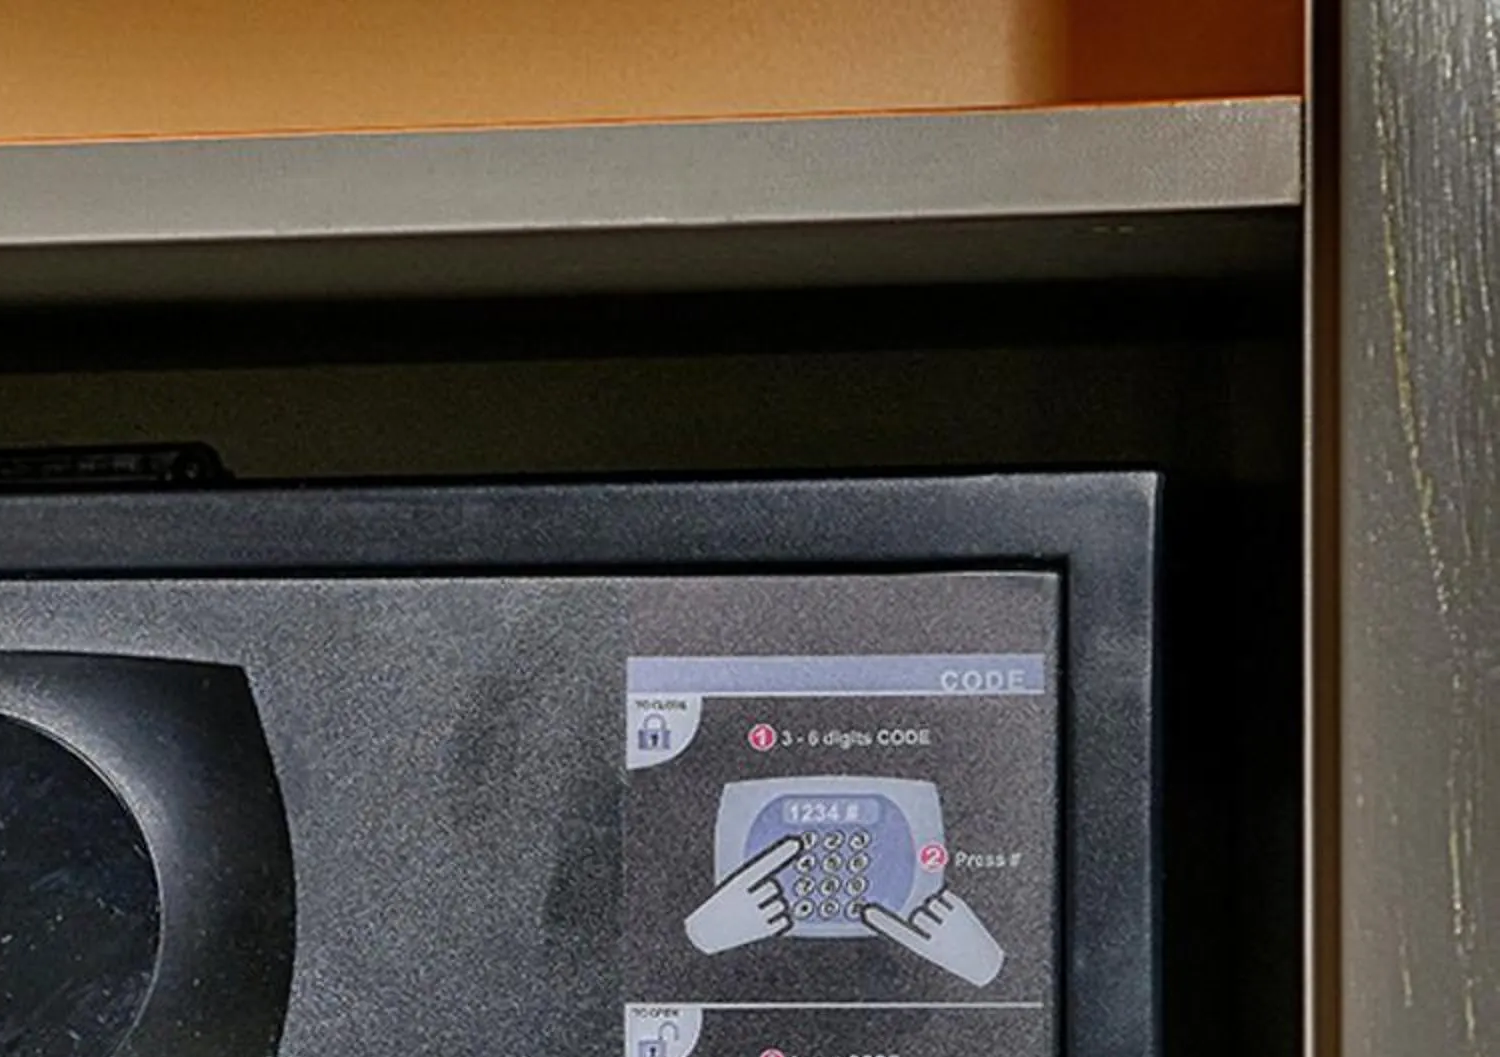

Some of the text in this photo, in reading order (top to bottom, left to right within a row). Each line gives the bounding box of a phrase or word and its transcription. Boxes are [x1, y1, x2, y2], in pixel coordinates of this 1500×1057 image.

[940, 670, 1026, 691] CODE
[781, 730, 793, 746] 3
[876, 729, 931, 745] CODE
[790, 803, 839, 822] 1234
[955, 851, 1006, 868] Press
